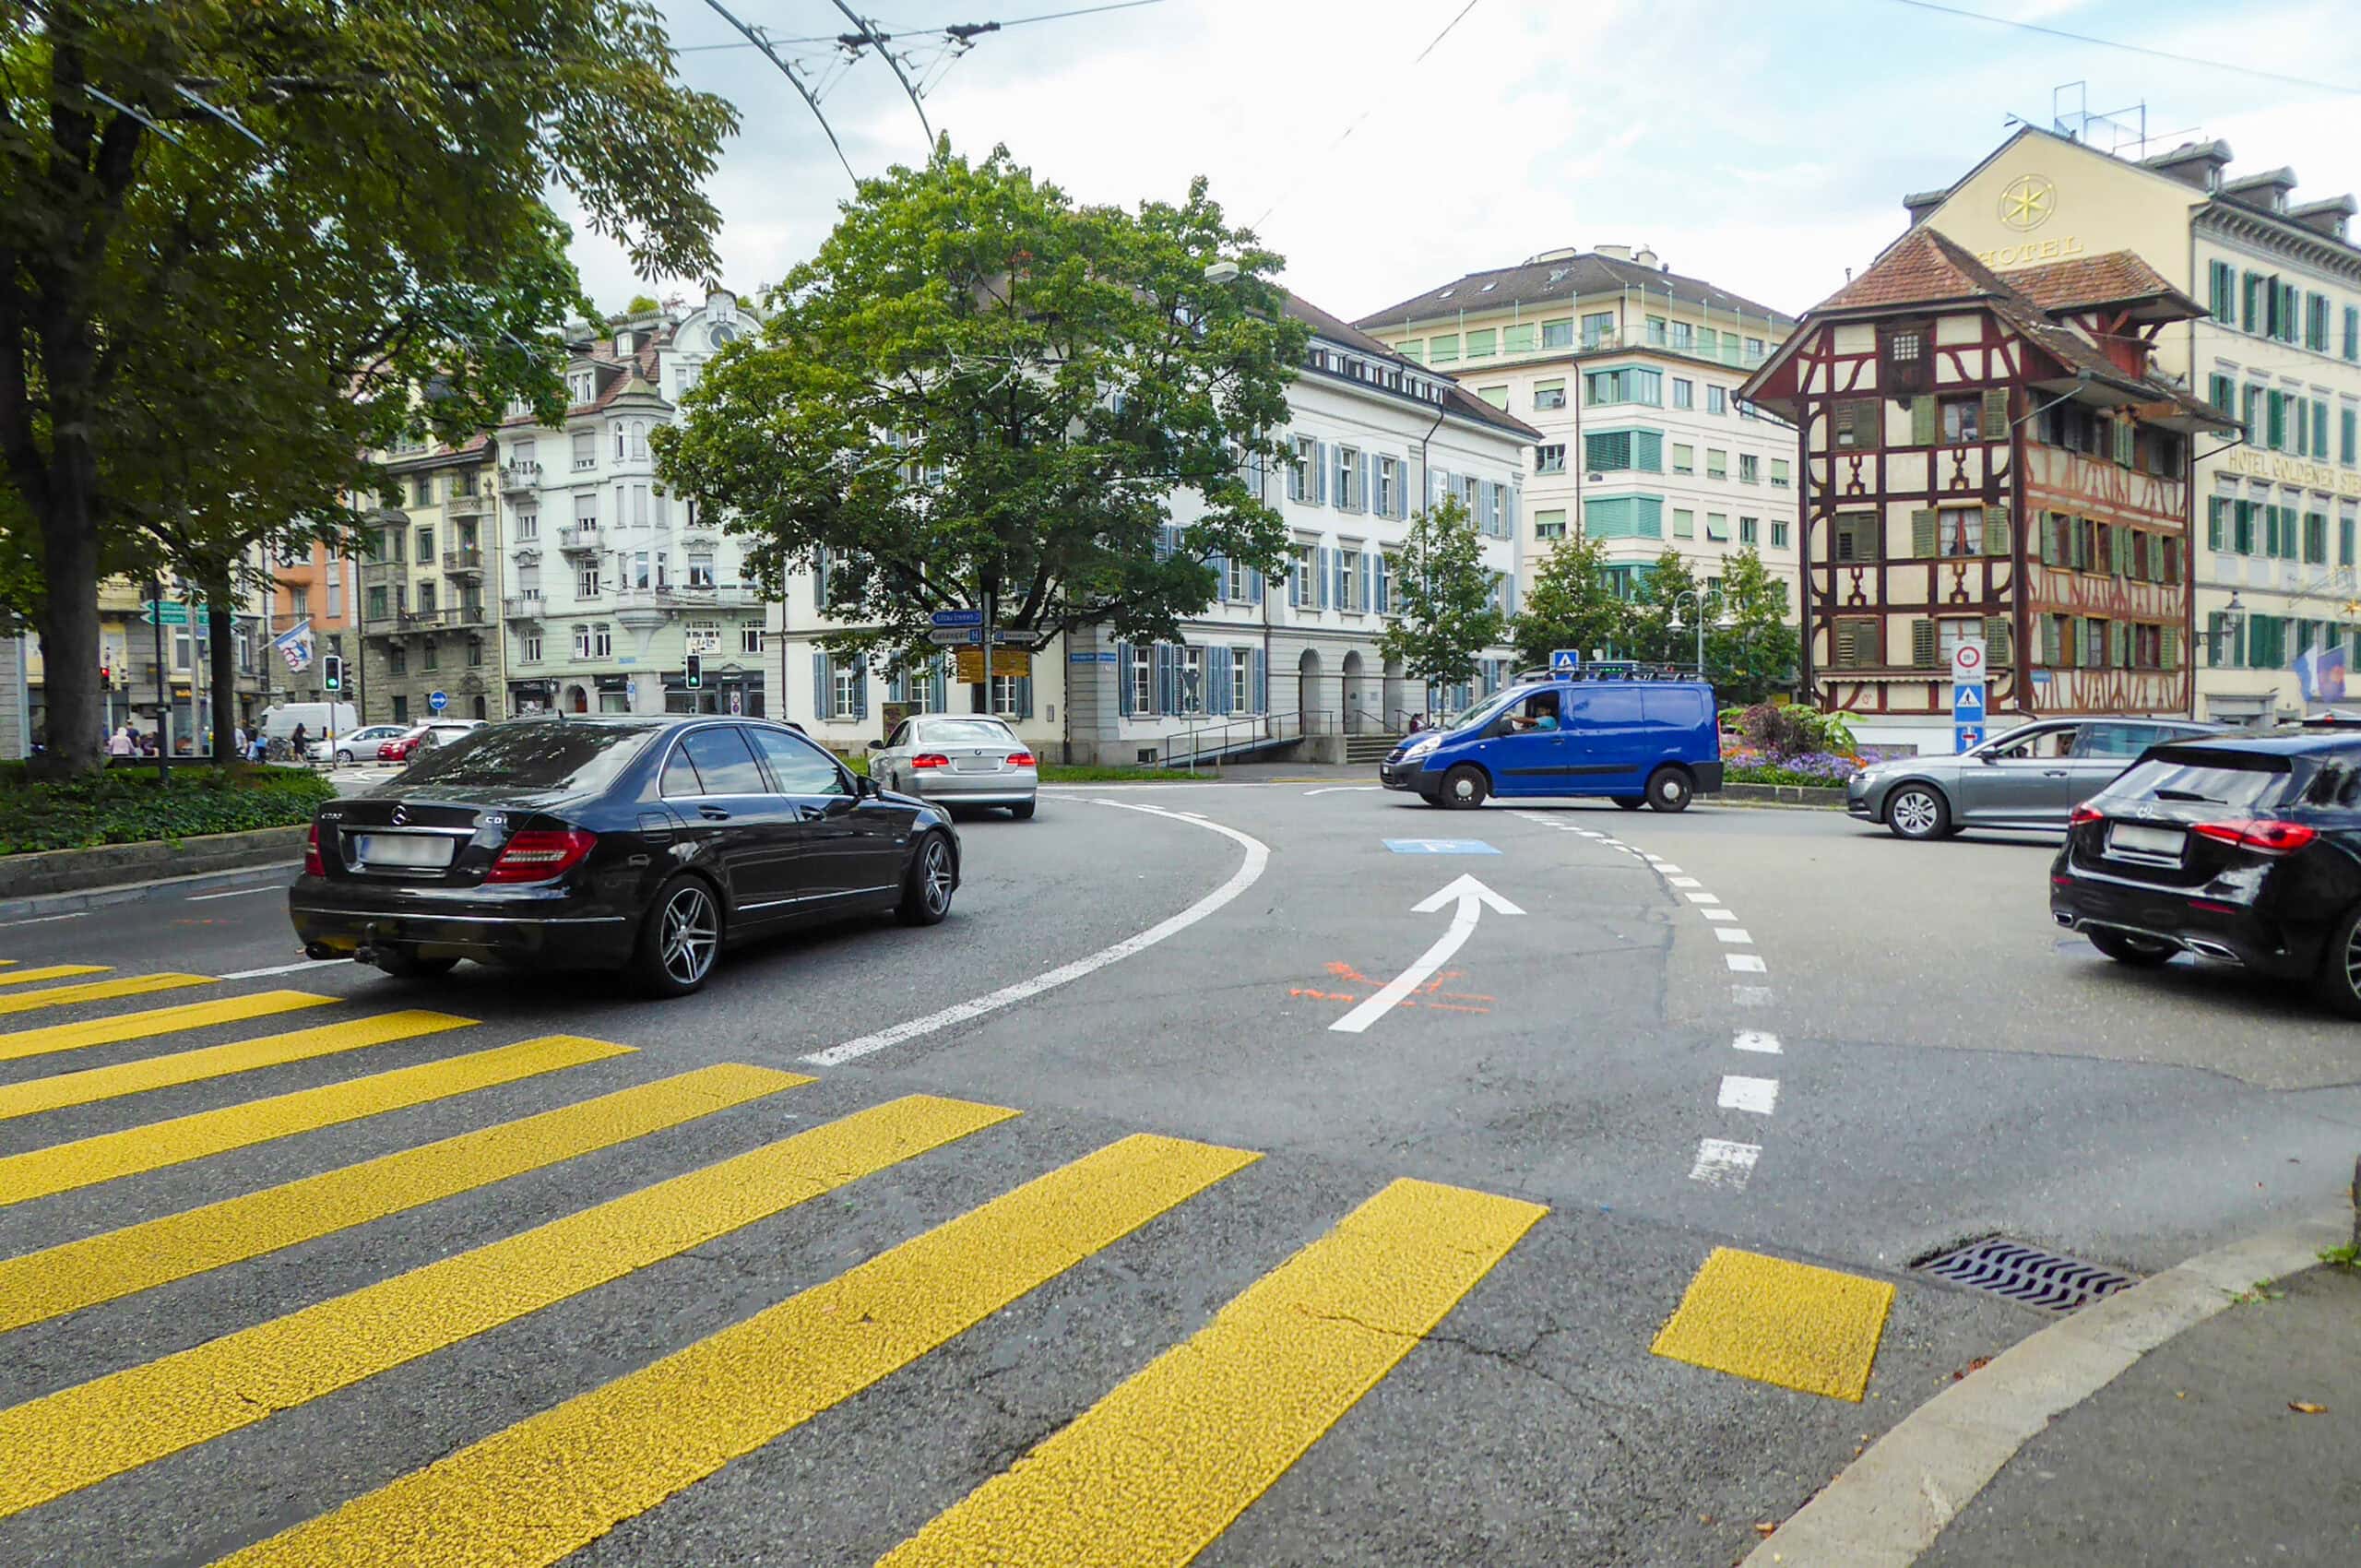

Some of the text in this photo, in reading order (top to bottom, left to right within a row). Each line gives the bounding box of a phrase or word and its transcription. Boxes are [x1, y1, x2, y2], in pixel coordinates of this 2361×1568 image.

[1976, 235, 2084, 268] HOTEL
[2228, 448, 2268, 475] HOTEL
[2272, 457, 2335, 487] GOLDENER
